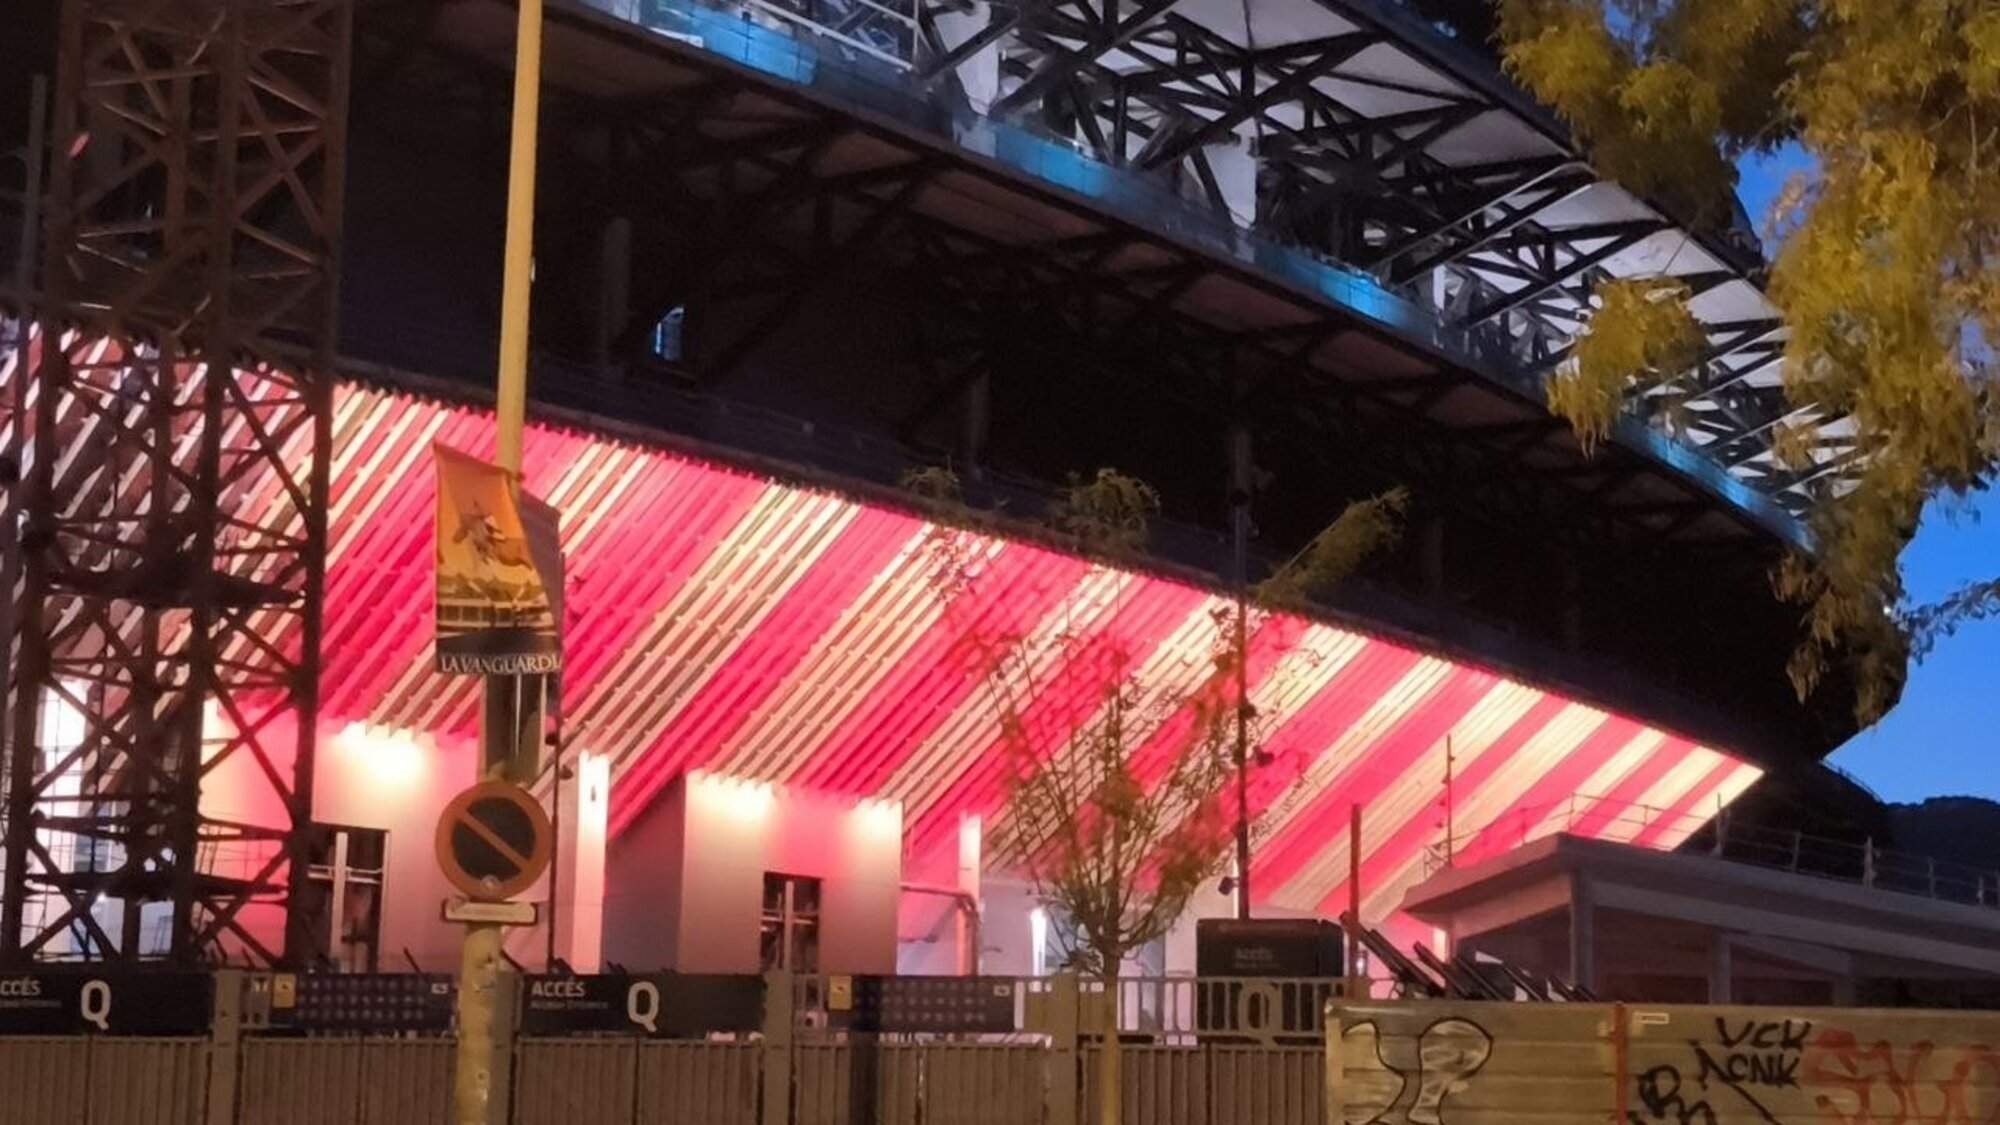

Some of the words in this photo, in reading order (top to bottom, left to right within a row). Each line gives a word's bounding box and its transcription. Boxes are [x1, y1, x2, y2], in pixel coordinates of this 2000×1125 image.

[441, 655, 461, 673] LA
[0, 976, 41, 996] CCÉS
[80, 979, 112, 1030] Q
[627, 981, 660, 1033] Q
